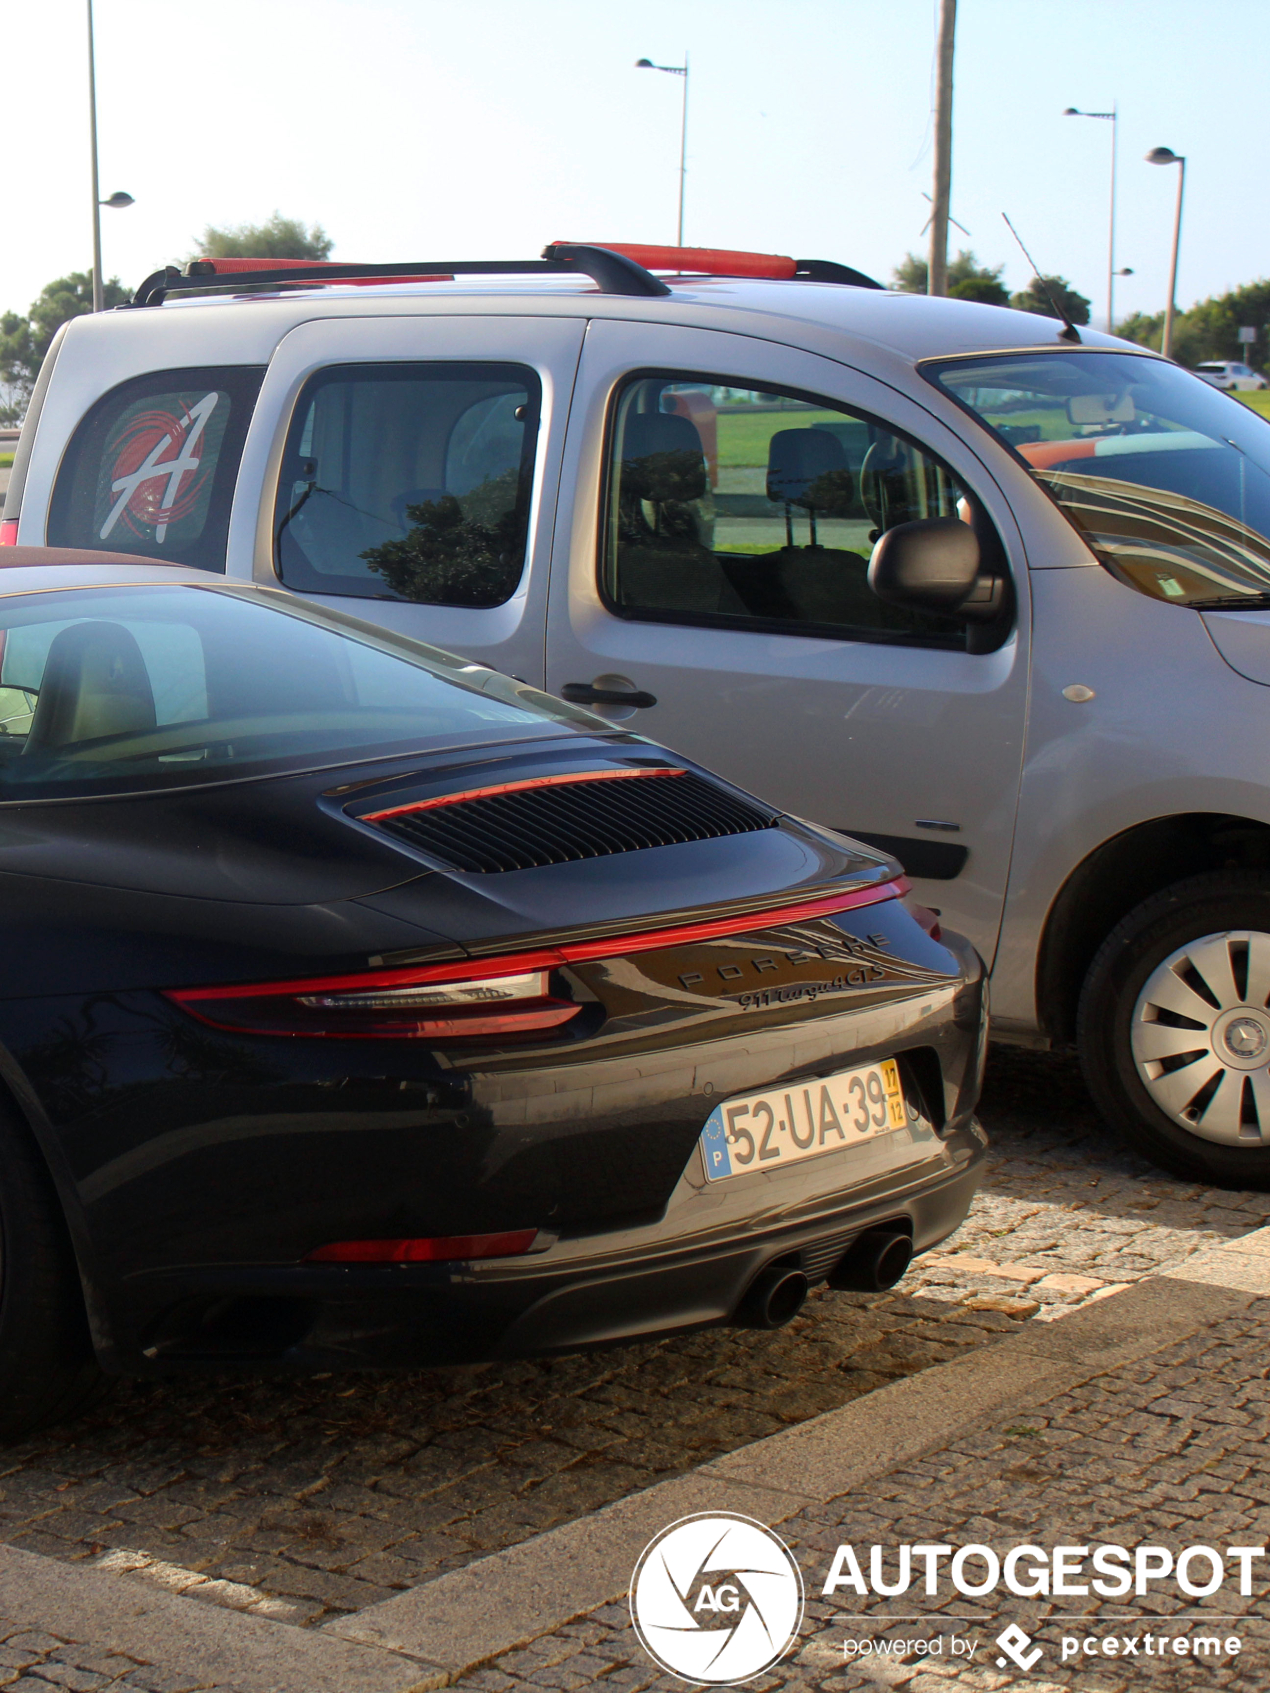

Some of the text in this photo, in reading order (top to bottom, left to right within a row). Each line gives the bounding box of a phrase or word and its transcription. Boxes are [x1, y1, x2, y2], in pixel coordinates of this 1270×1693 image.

[677, 932, 891, 989] PORSCHE
[738, 991, 771, 1011] 911
[884, 1068, 899, 1088] 17
[890, 1102, 904, 1123] 12
[713, 1150, 723, 1168] P
